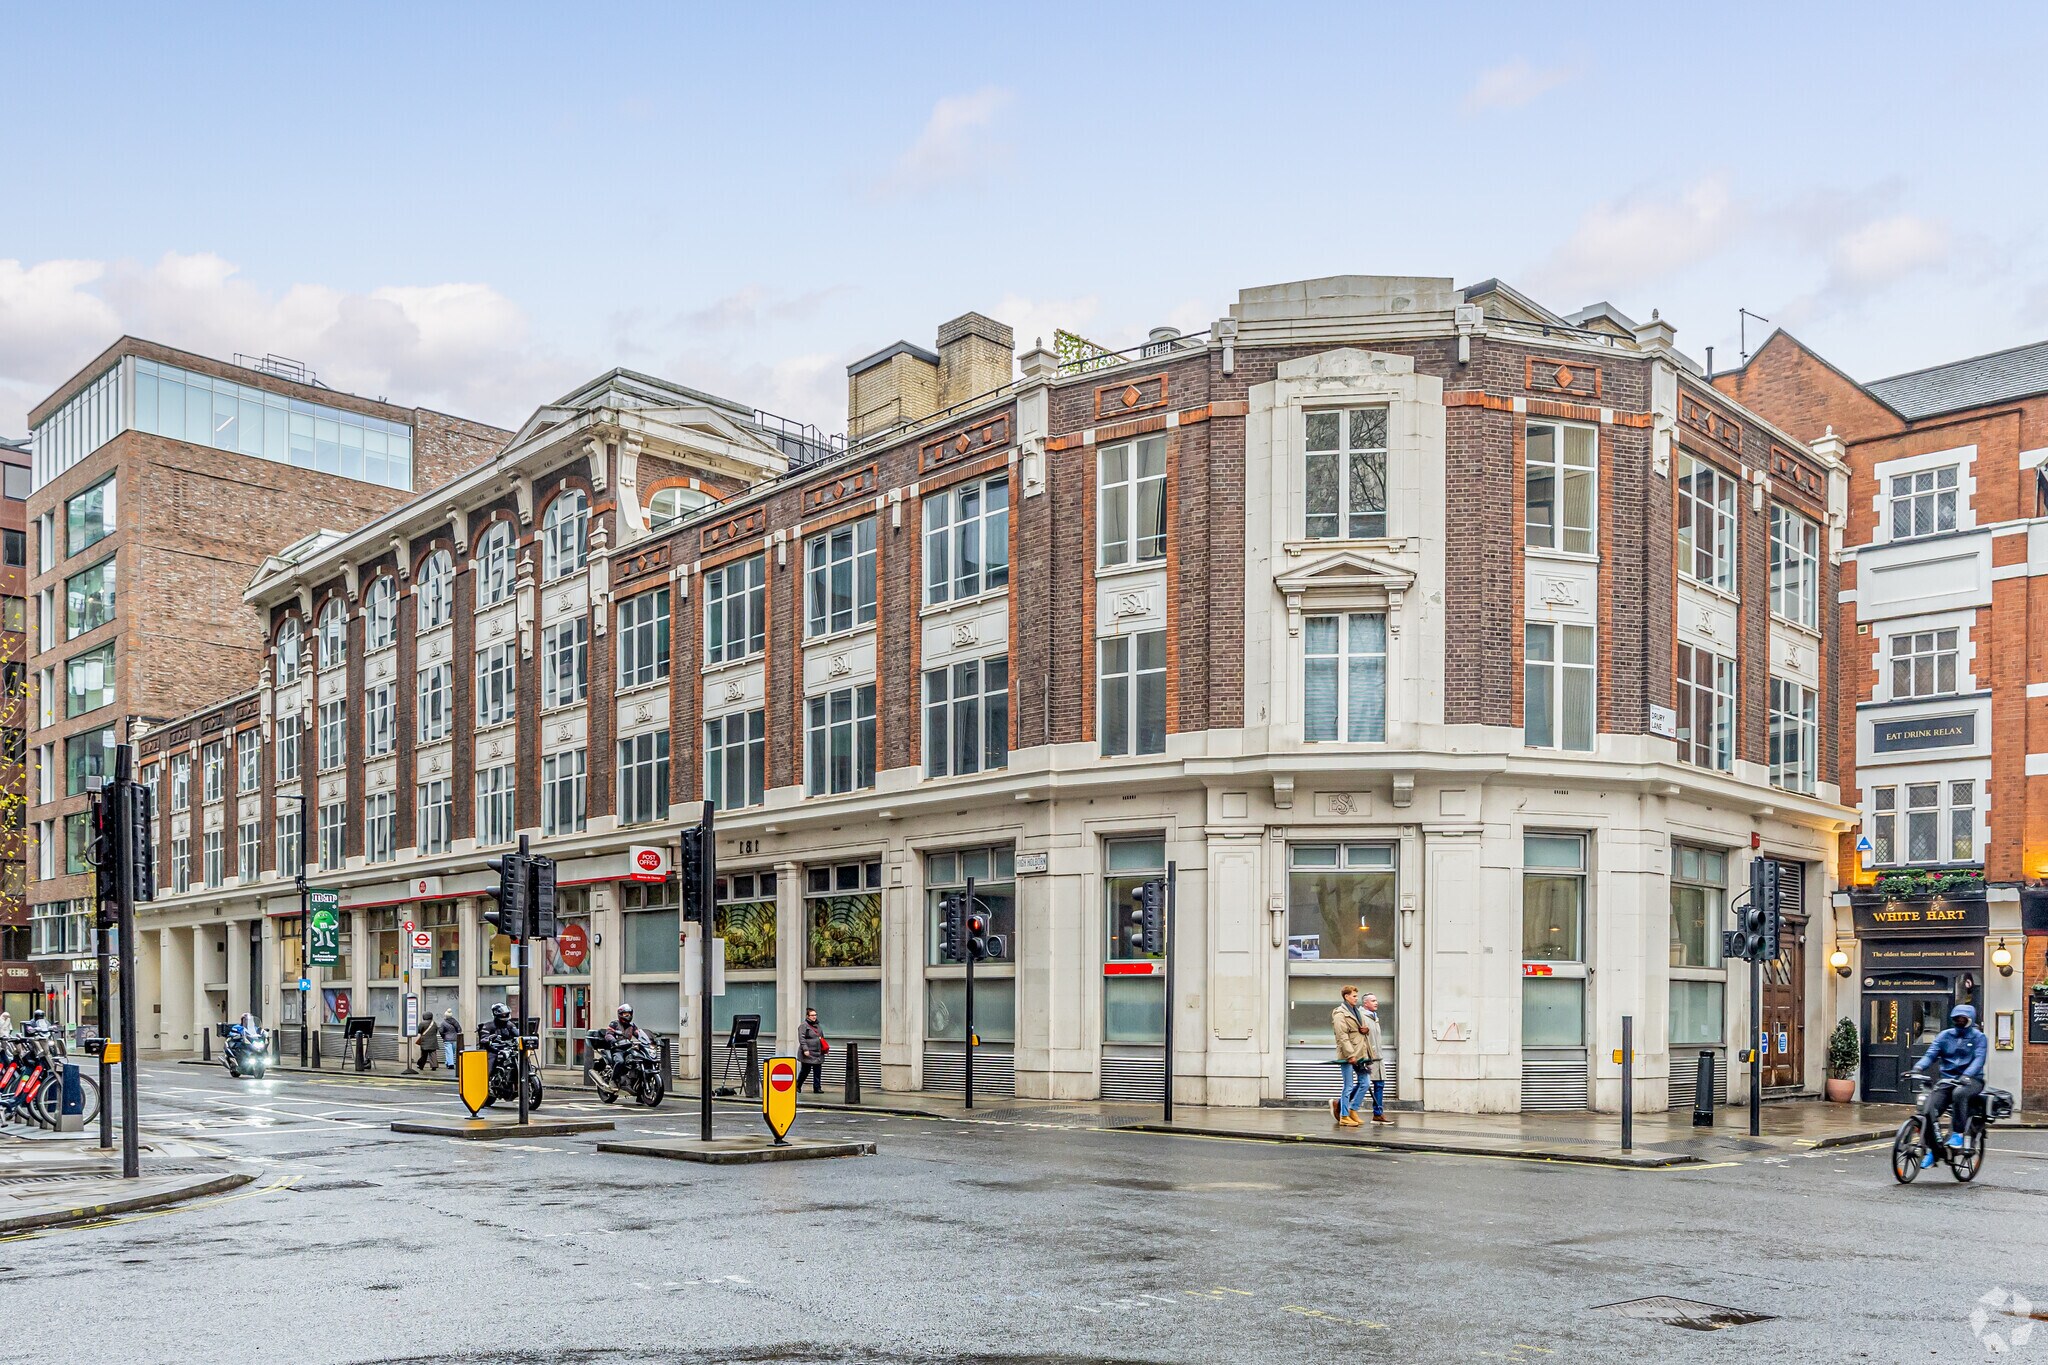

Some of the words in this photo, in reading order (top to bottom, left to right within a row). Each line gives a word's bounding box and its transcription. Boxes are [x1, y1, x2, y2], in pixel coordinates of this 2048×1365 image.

[1651, 712, 1665, 722] DRURY
[1651, 721, 1662, 731] LANE
[1886, 732, 1902, 741] EAT
[1903, 729, 1931, 739] DRINK
[1933, 726, 1963, 737] RELAX
[638, 859, 658, 867] OFFICE
[1873, 911, 1920, 922] WHITE
[1926, 910, 1966, 920] HART
[407, 922, 413, 930] S
[564, 949, 582, 957] Change
